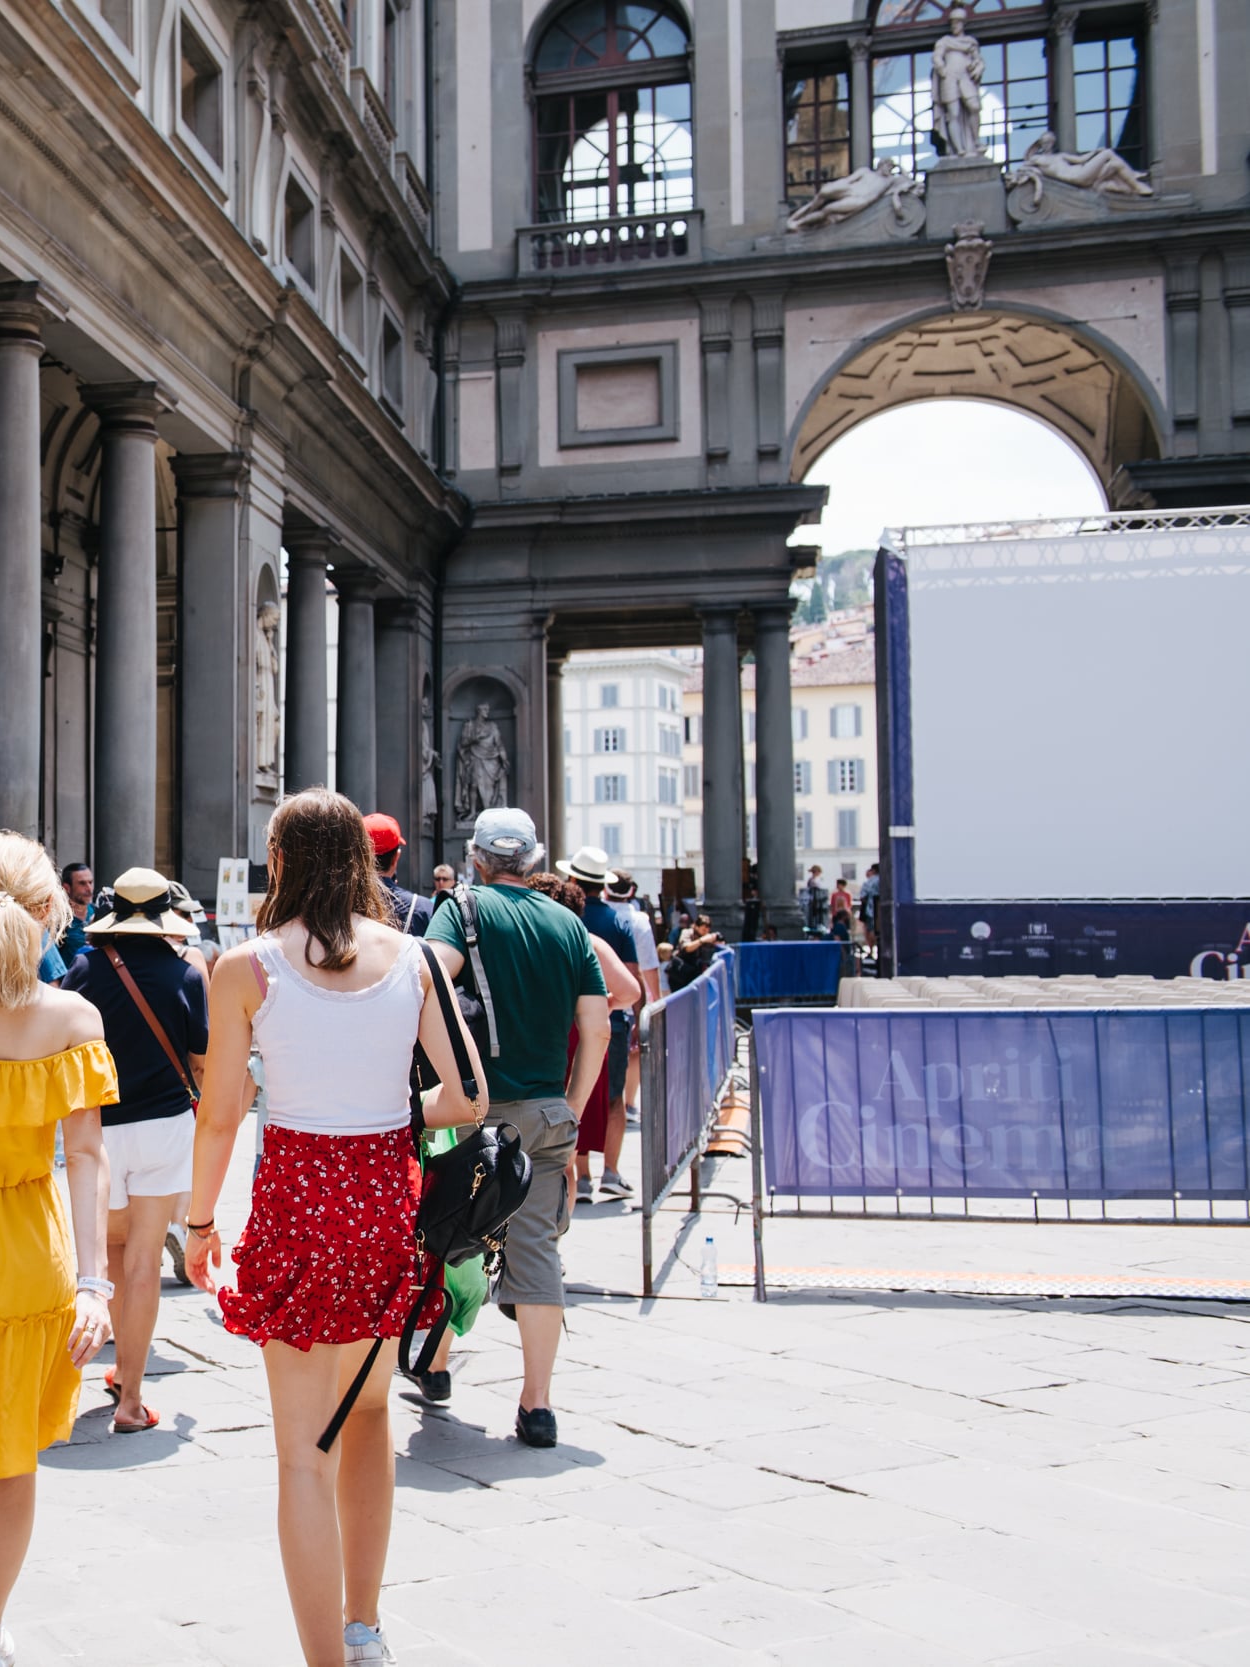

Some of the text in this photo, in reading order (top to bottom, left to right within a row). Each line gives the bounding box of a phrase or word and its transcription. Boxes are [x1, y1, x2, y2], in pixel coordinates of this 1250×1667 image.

[1190, 950, 1250, 979] Ci
[873, 1047, 1078, 1118] Apriti
[800, 1101, 1113, 1170] Cinema
